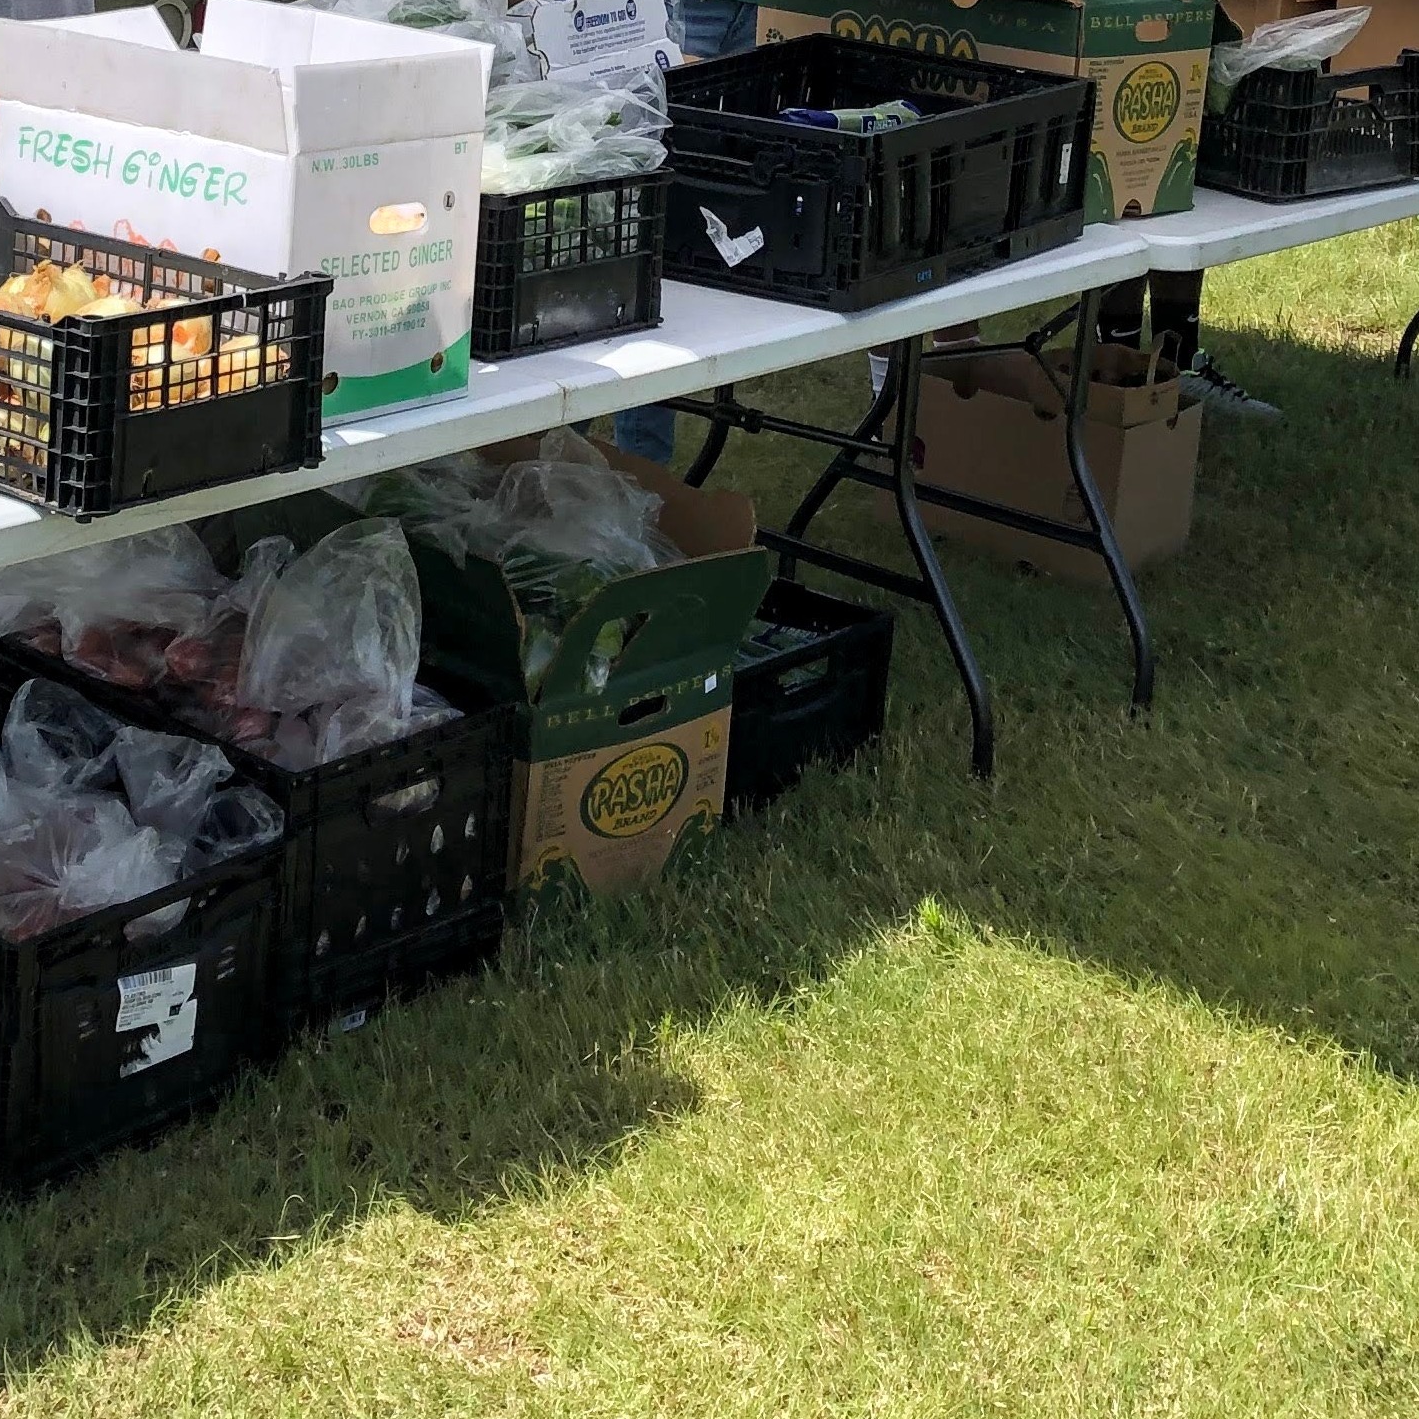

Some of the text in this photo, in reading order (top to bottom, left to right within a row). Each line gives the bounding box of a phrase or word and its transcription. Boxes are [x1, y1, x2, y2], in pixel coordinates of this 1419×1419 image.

[1090, 15, 1134, 29] BELL
[1120, 80, 1175, 124] PASHA
[454, 140, 468, 155] BT
[18, 125, 248, 206] FRESH GINGER
[320, 239, 453, 279] SELECTED GINGER
[332, 297, 356, 311] BAO
[408, 283, 438, 299] GROUP
[346, 311, 387, 325] VERNON
[548, 705, 615, 728] BELL
[589, 758, 682, 822] PASHA
[613, 808, 658, 831] BRAND
